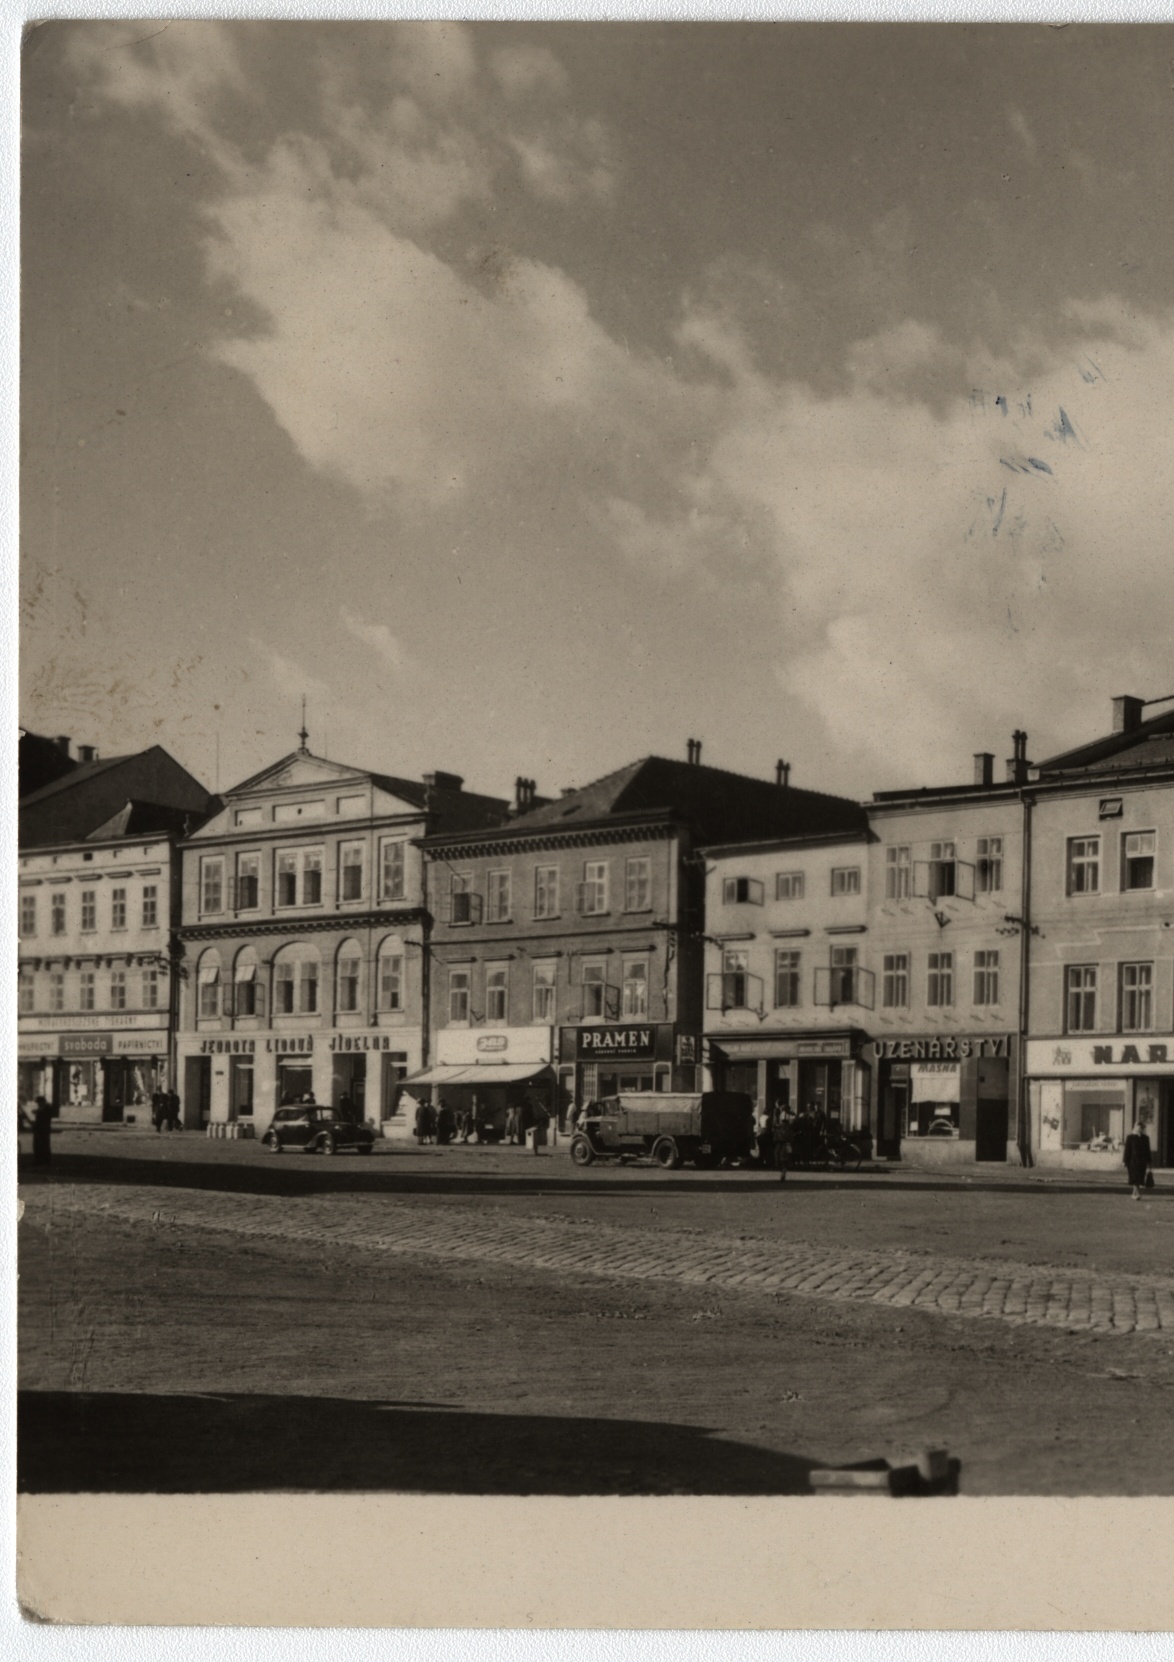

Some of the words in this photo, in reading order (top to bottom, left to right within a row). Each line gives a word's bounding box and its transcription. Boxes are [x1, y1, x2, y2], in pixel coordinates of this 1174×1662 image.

[64, 1037, 107, 1050] svoboda
[200, 1039, 256, 1054] JEDNOTA
[581, 1031, 650, 1048] PRAMEN
[872, 1035, 1010, 1059] UZENÁŘSTVÍ
[917, 1063, 958, 1074] MASNA
